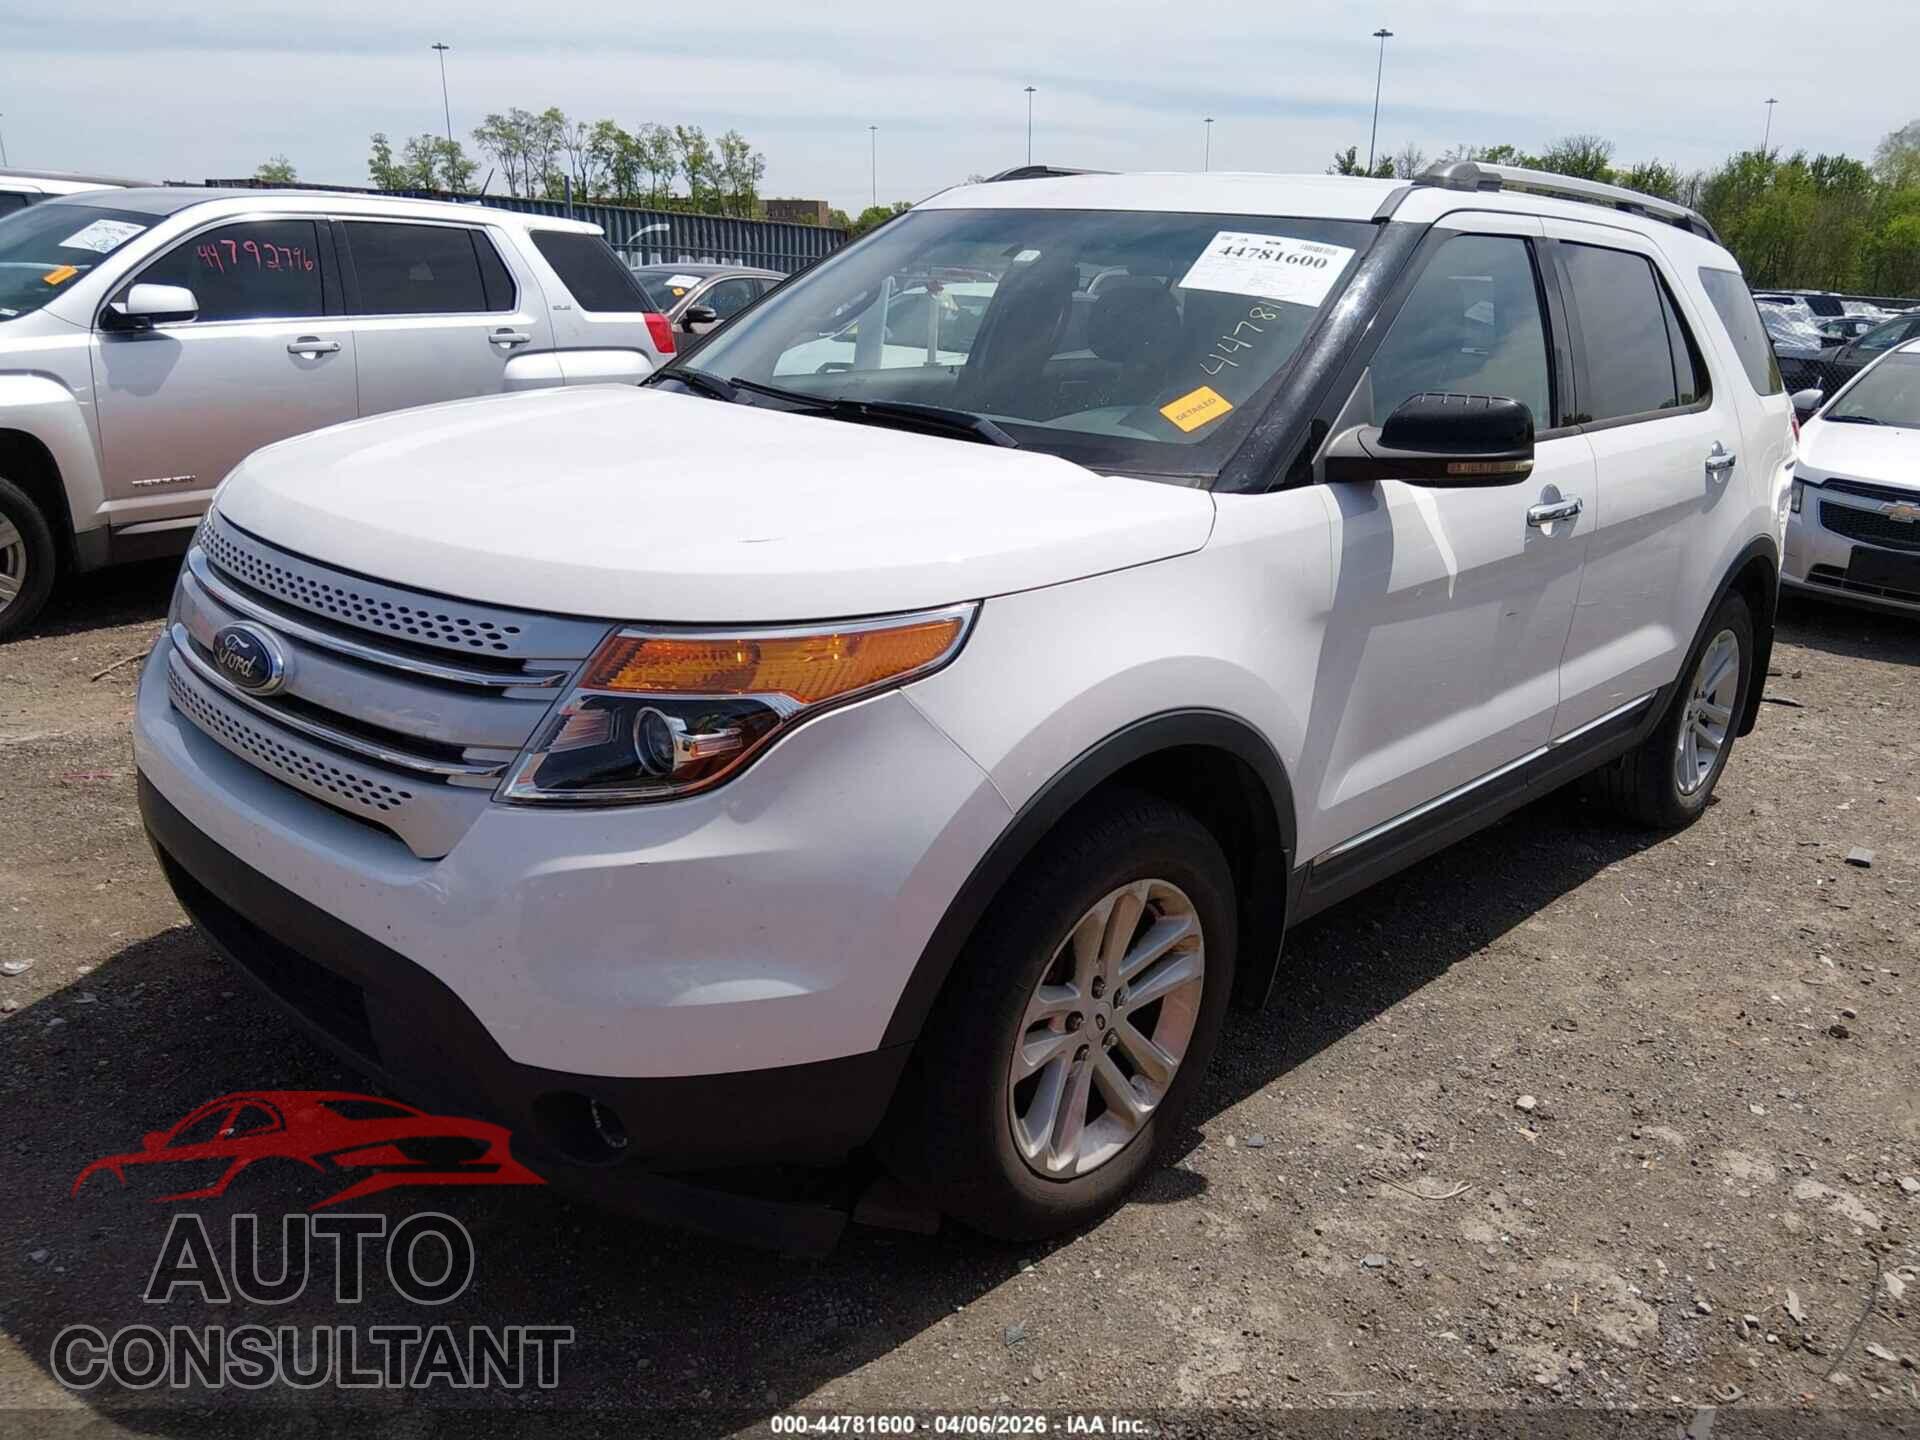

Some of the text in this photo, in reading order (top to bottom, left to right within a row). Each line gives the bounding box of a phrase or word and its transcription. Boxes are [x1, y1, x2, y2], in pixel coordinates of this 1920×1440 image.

[1218, 245, 1328, 269] 44781600
[1175, 397, 1217, 421] DETAILED
[219, 633, 257, 678] Ford
